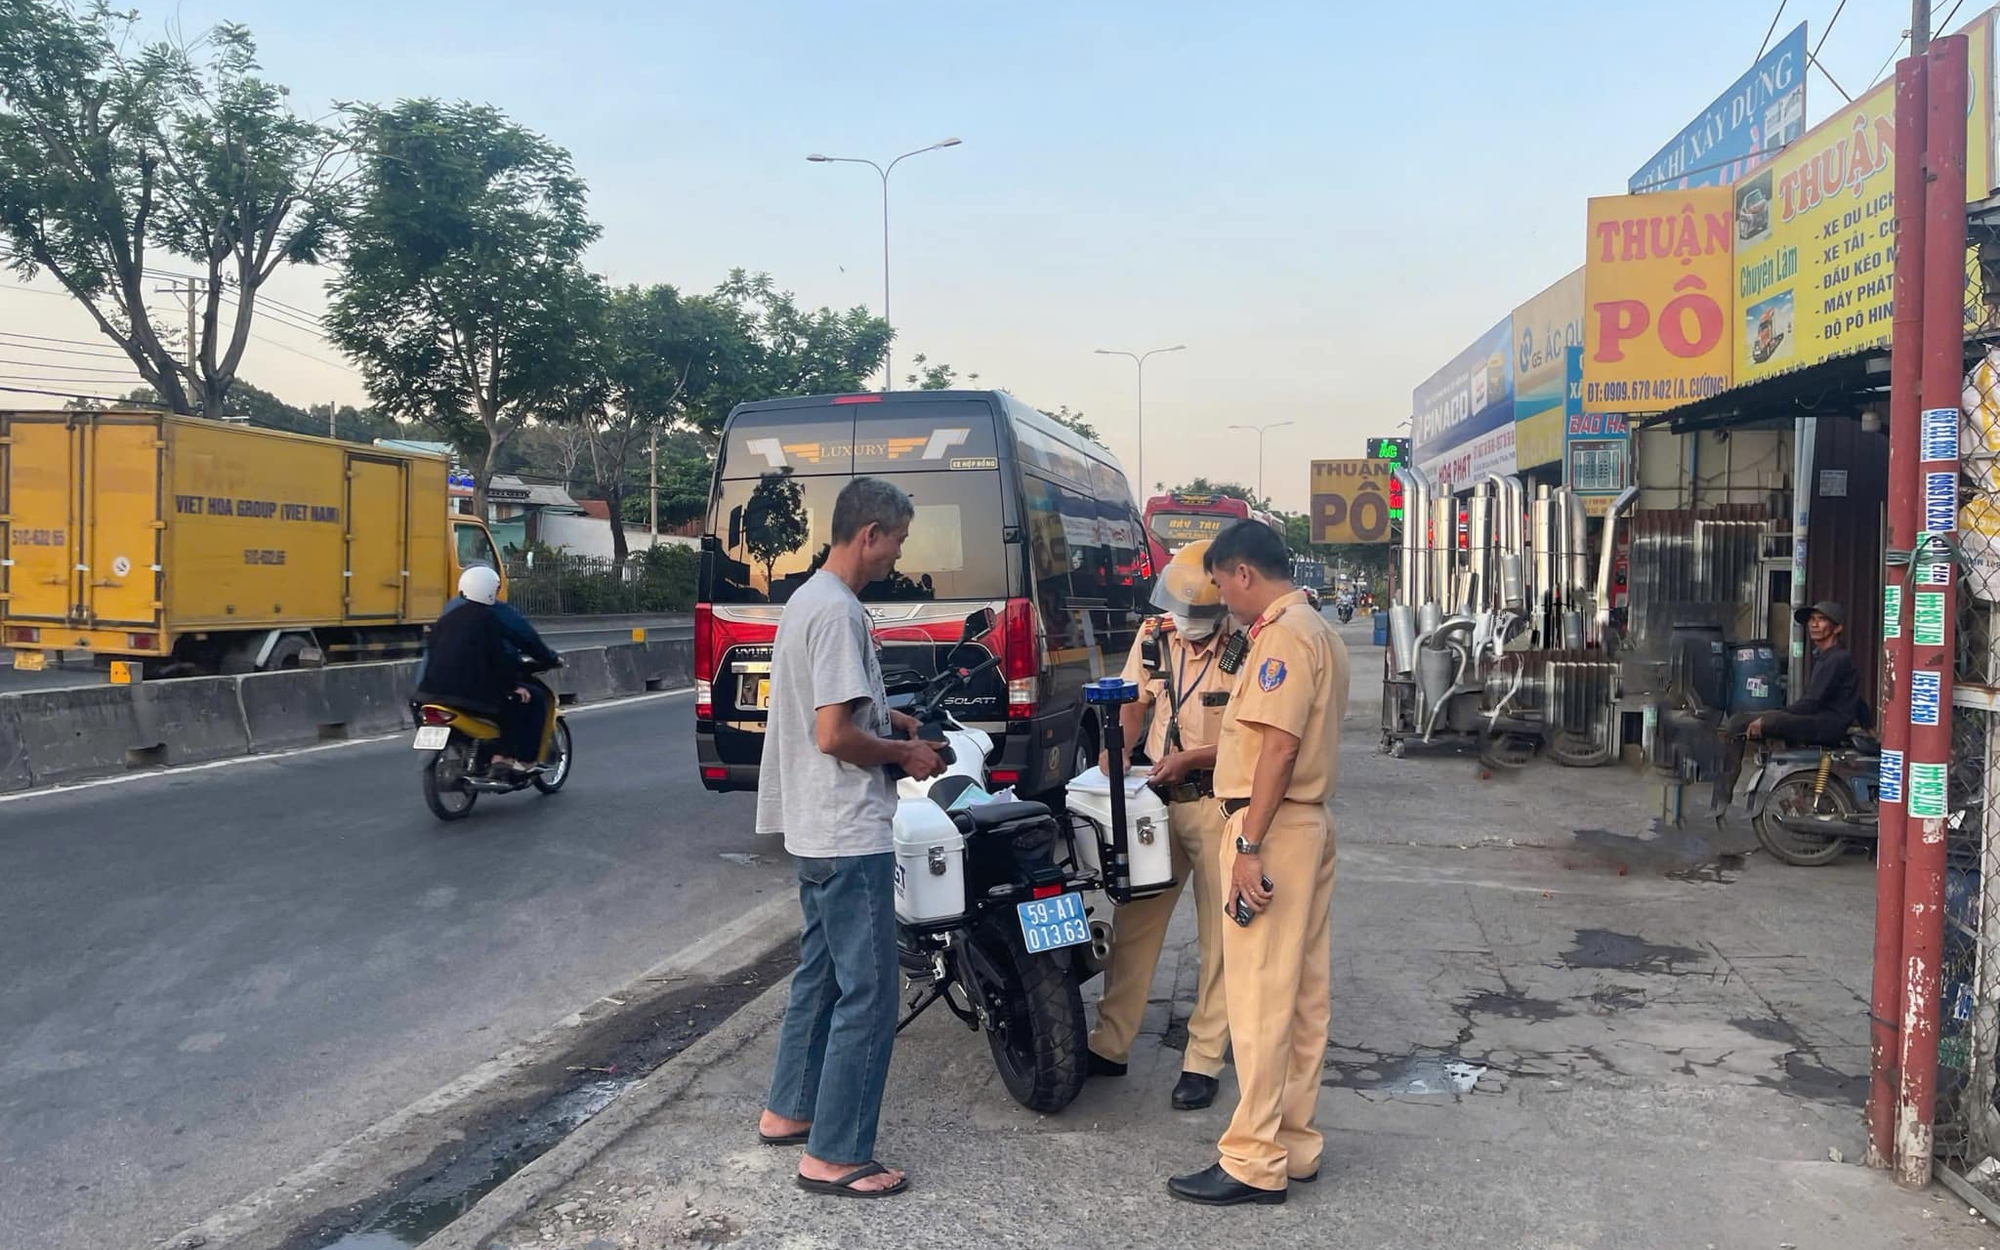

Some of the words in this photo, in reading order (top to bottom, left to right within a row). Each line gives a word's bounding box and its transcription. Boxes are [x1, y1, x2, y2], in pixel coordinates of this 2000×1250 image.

[1689, 108, 1728, 165] XÂY
[1731, 52, 1793, 130] DỰNG
[1596, 203, 1732, 266] THUẬN
[1822, 219, 1839, 240] XE
[1843, 210, 1861, 230] DU
[1823, 244, 1840, 265] XE
[1824, 288, 1852, 315] MÁY
[1593, 274, 1724, 364] PÔ
[821, 443, 887, 458] LUXURY
[1313, 460, 1388, 479] THUẬN
[175, 495, 204, 515] VIET
[207, 497, 233, 517] HOA
[237, 499, 277, 519] GROUP
[1311, 481, 1389, 541] PÔ
[944, 696, 997, 705] SOLATI
[1027, 897, 1075, 925] 59-A1
[1029, 919, 1086, 949] 013.63
